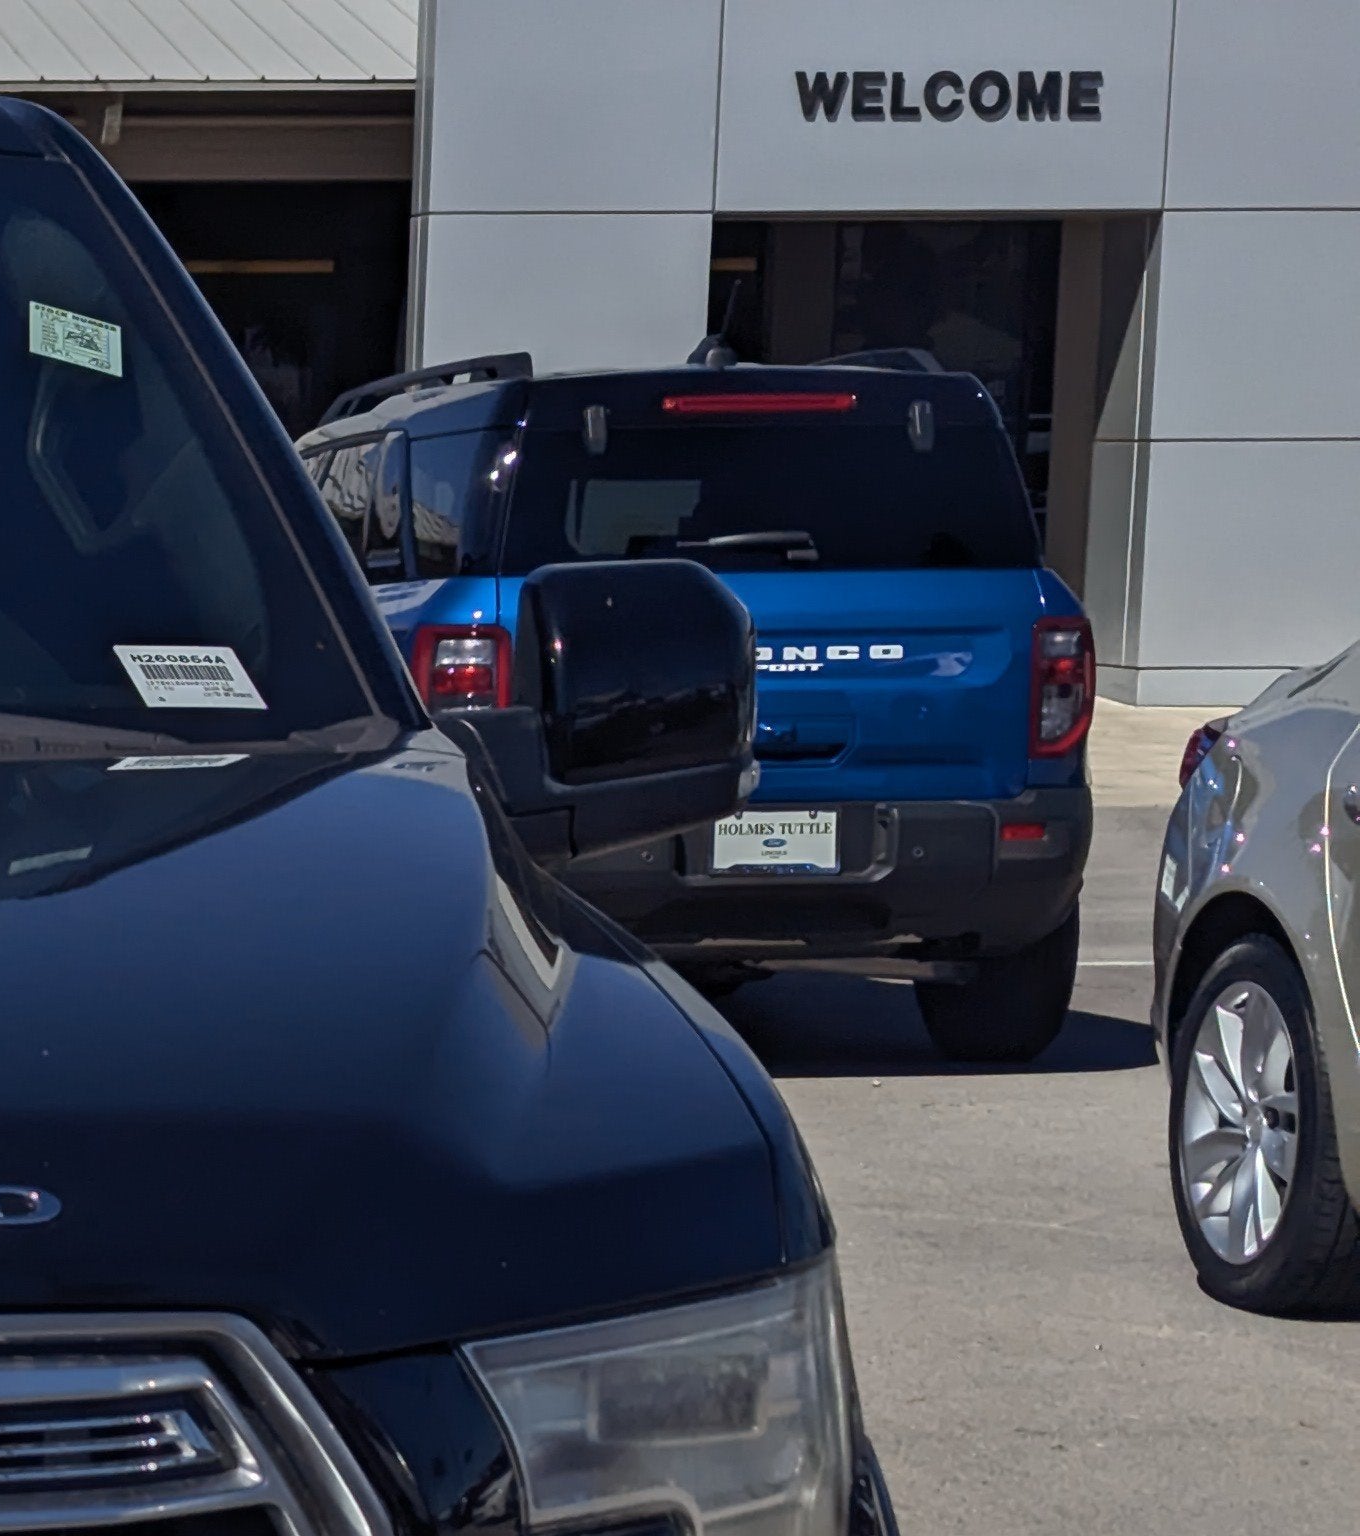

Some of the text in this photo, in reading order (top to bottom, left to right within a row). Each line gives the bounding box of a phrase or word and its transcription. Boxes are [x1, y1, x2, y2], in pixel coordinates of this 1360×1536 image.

[795, 70, 1103, 122] WELCOME
[756, 645, 903, 661] ONCO
[756, 663, 824, 672] PORT
[718, 822, 833, 836] HOLMES TUTTLE
